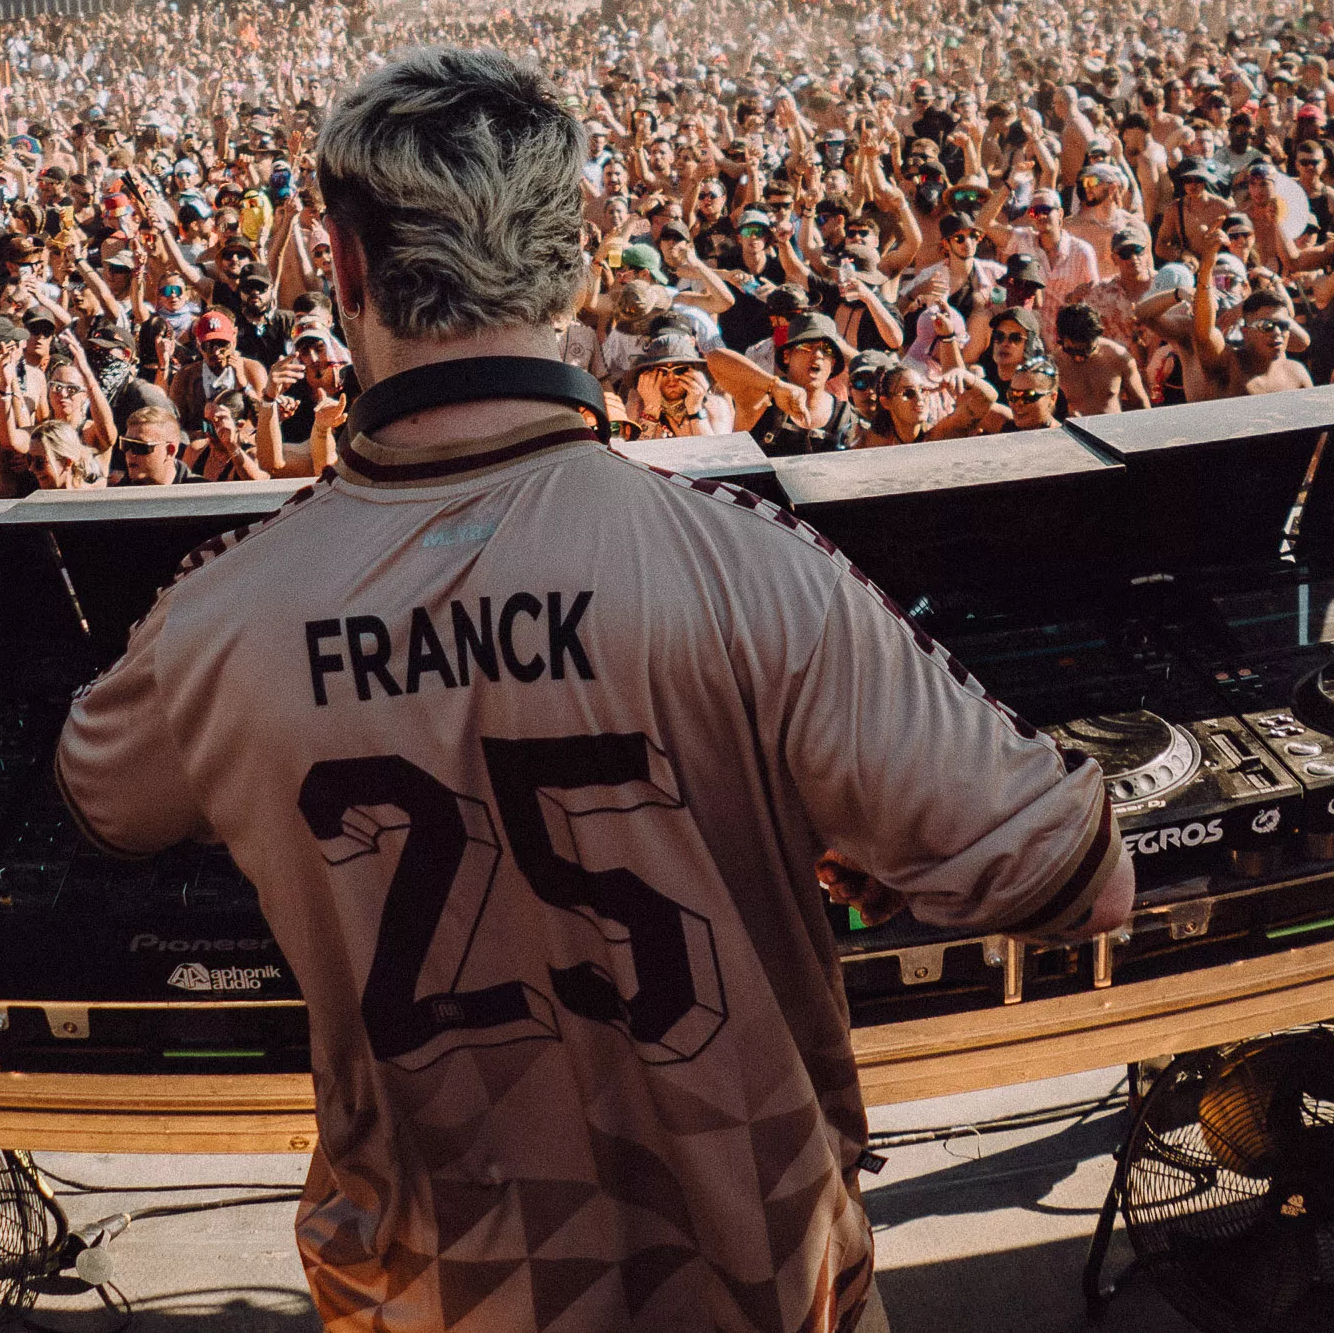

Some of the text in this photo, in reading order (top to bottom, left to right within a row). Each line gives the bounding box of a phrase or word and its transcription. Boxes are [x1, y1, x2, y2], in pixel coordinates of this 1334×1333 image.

[304, 591, 595, 706] FRANCK
[1121, 818, 1224, 858] EGROS
[298, 733, 726, 1067] 25
[130, 933, 274, 952] Pioneer
[211, 965, 282, 980] aphonik
[213, 977, 262, 990] audio
